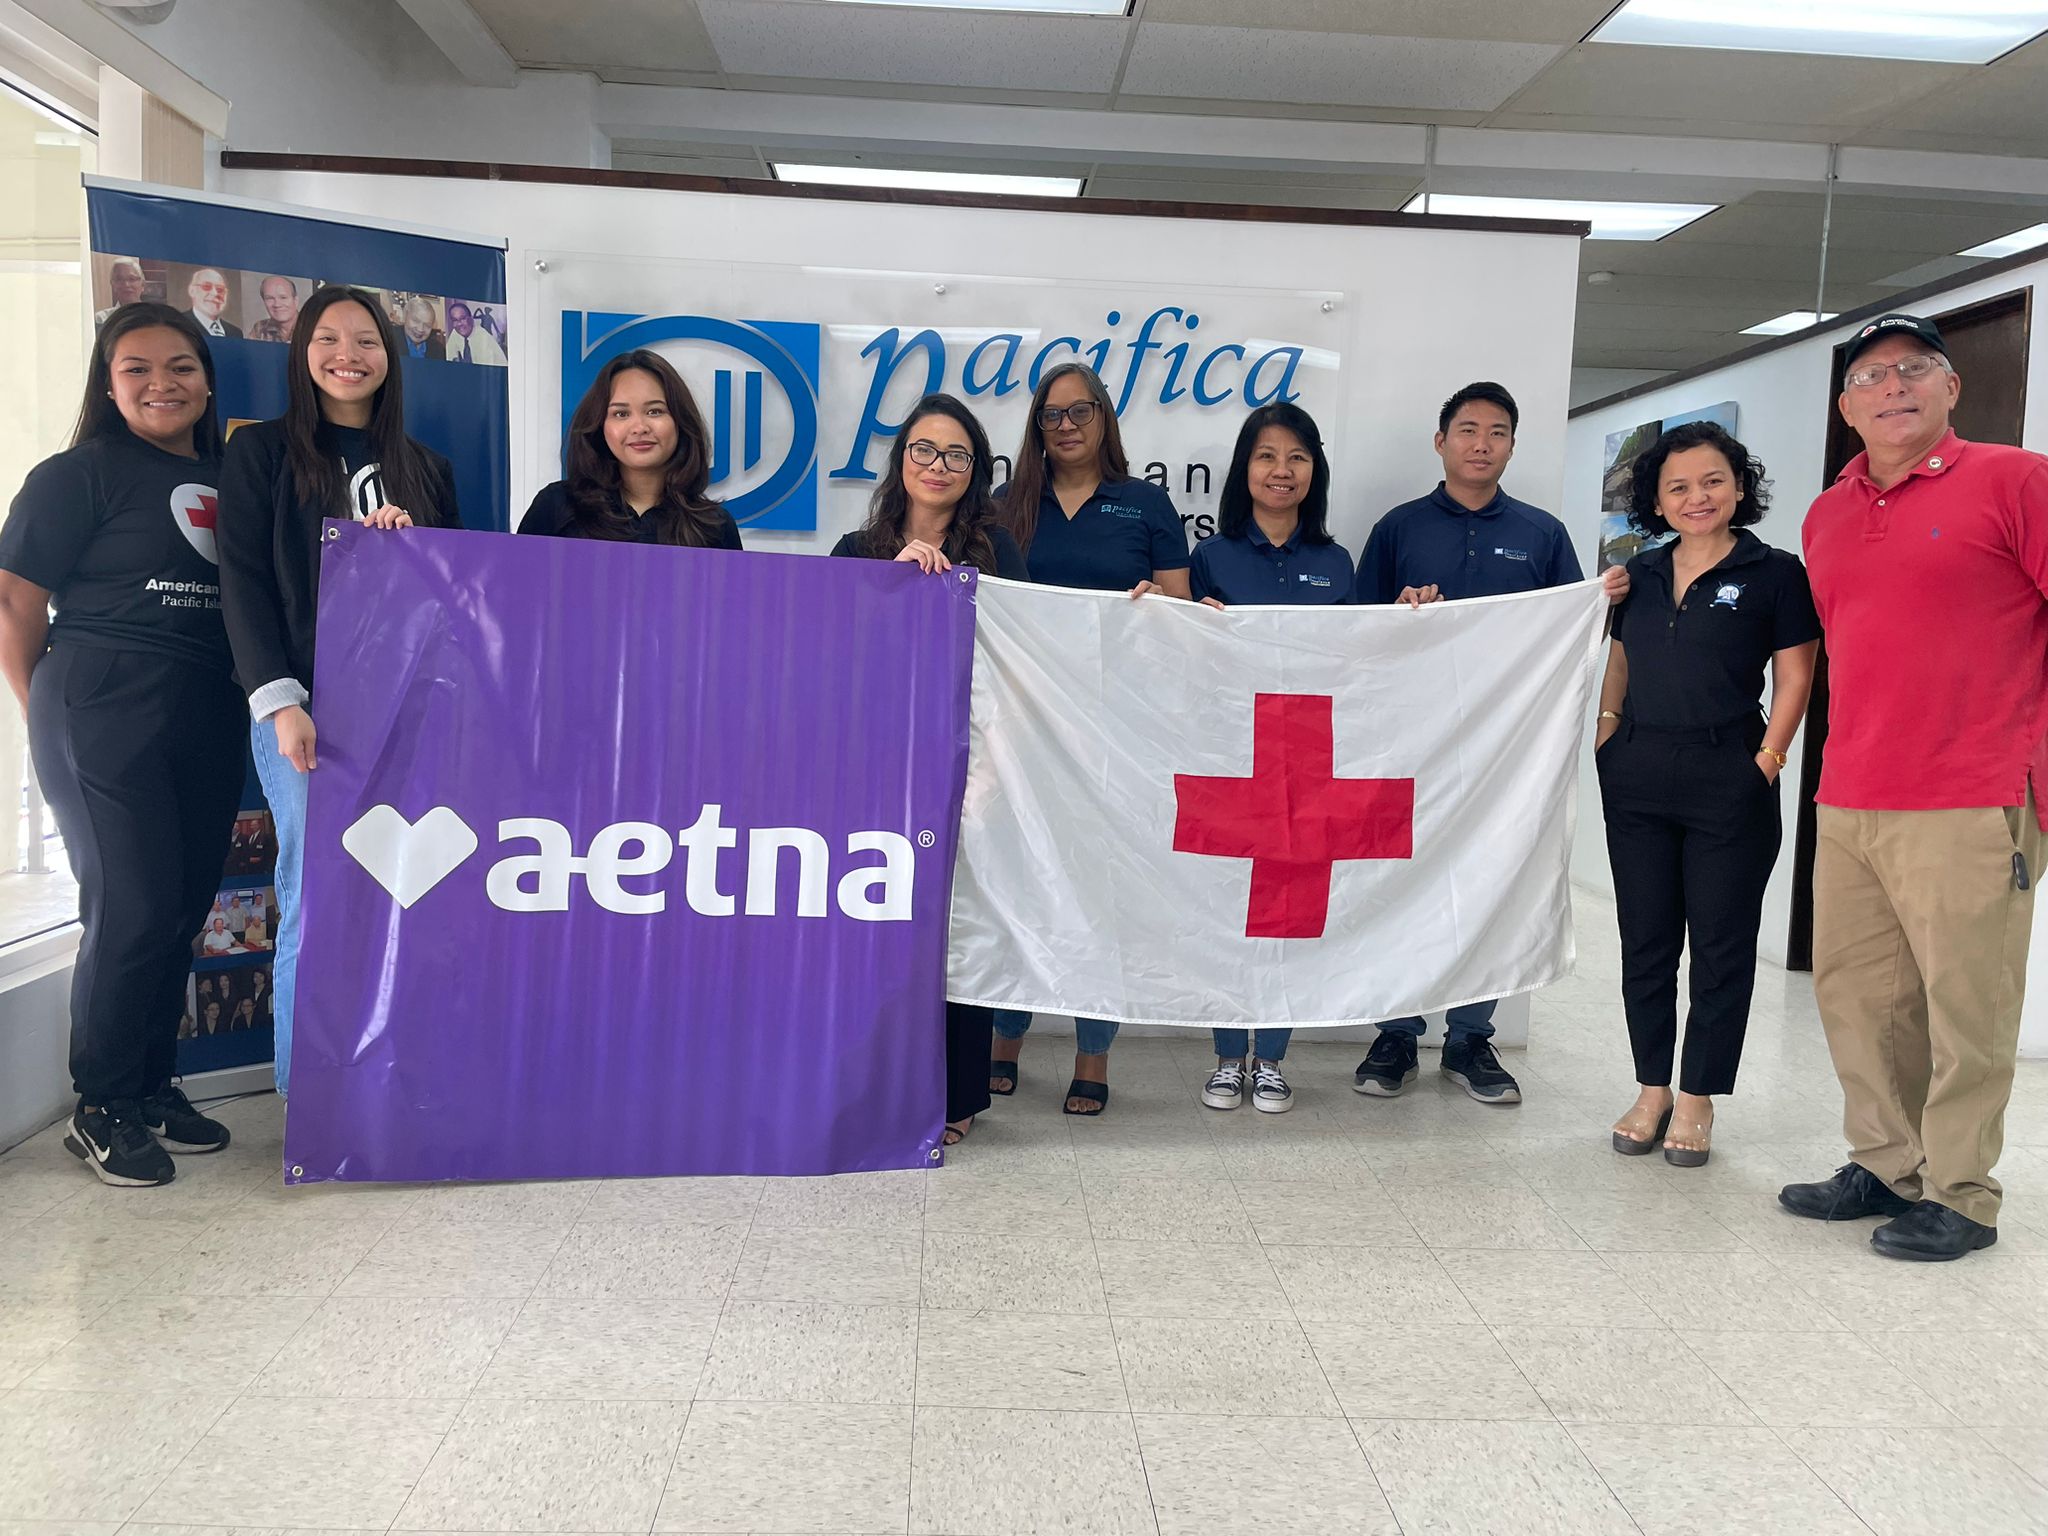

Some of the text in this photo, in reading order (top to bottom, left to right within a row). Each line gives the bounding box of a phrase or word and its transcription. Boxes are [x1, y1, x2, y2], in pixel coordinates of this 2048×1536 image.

[828, 306, 1304, 481] pacifica
[144, 578, 219, 594] American
[161, 594, 202, 608] Pacific
